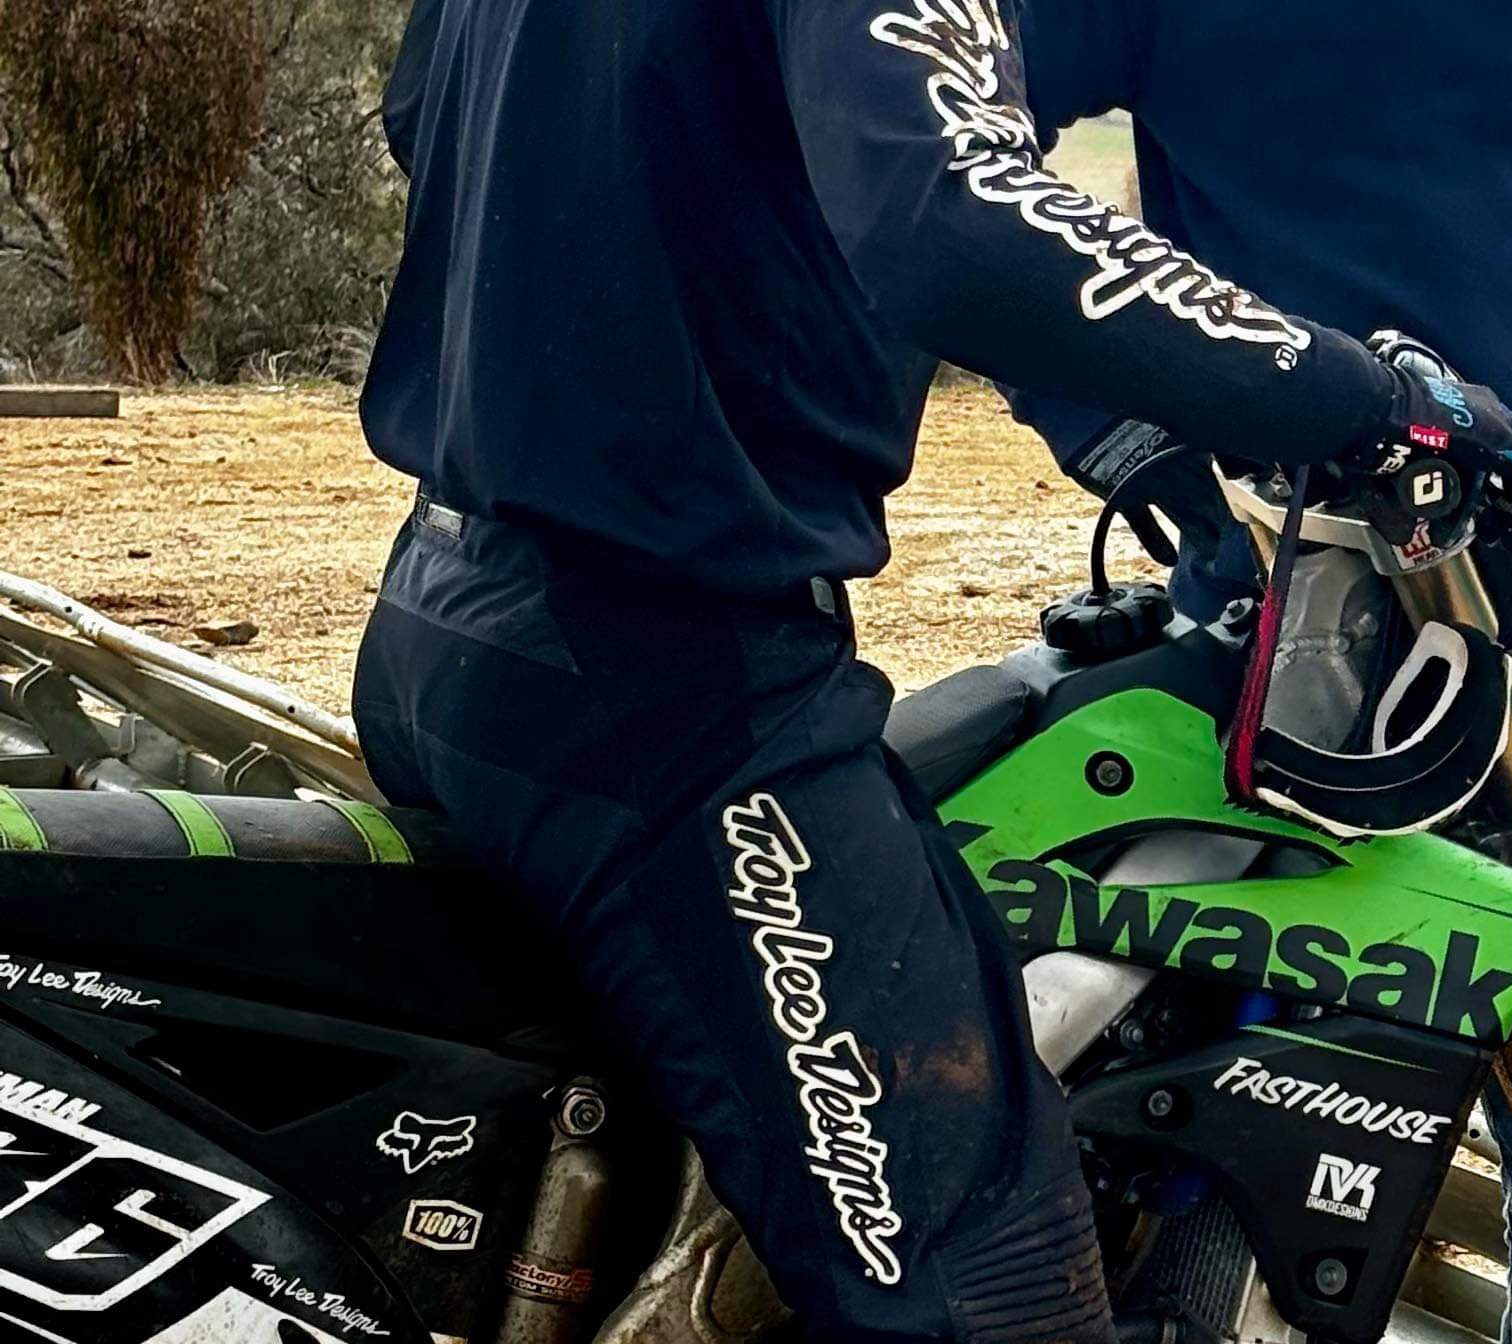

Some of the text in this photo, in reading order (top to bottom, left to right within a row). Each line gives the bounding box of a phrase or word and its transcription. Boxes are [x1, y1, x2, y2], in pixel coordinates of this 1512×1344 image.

[27, 962, 70, 990] Lee
[72, 971, 162, 1010] Designs
[723, 792, 903, 1285] Troy Lee Designs
[1213, 1056, 1452, 1144] FASTHOUSE
[416, 1210, 472, 1242] 100%
[251, 1262, 391, 1336] Troy Lee Designs
